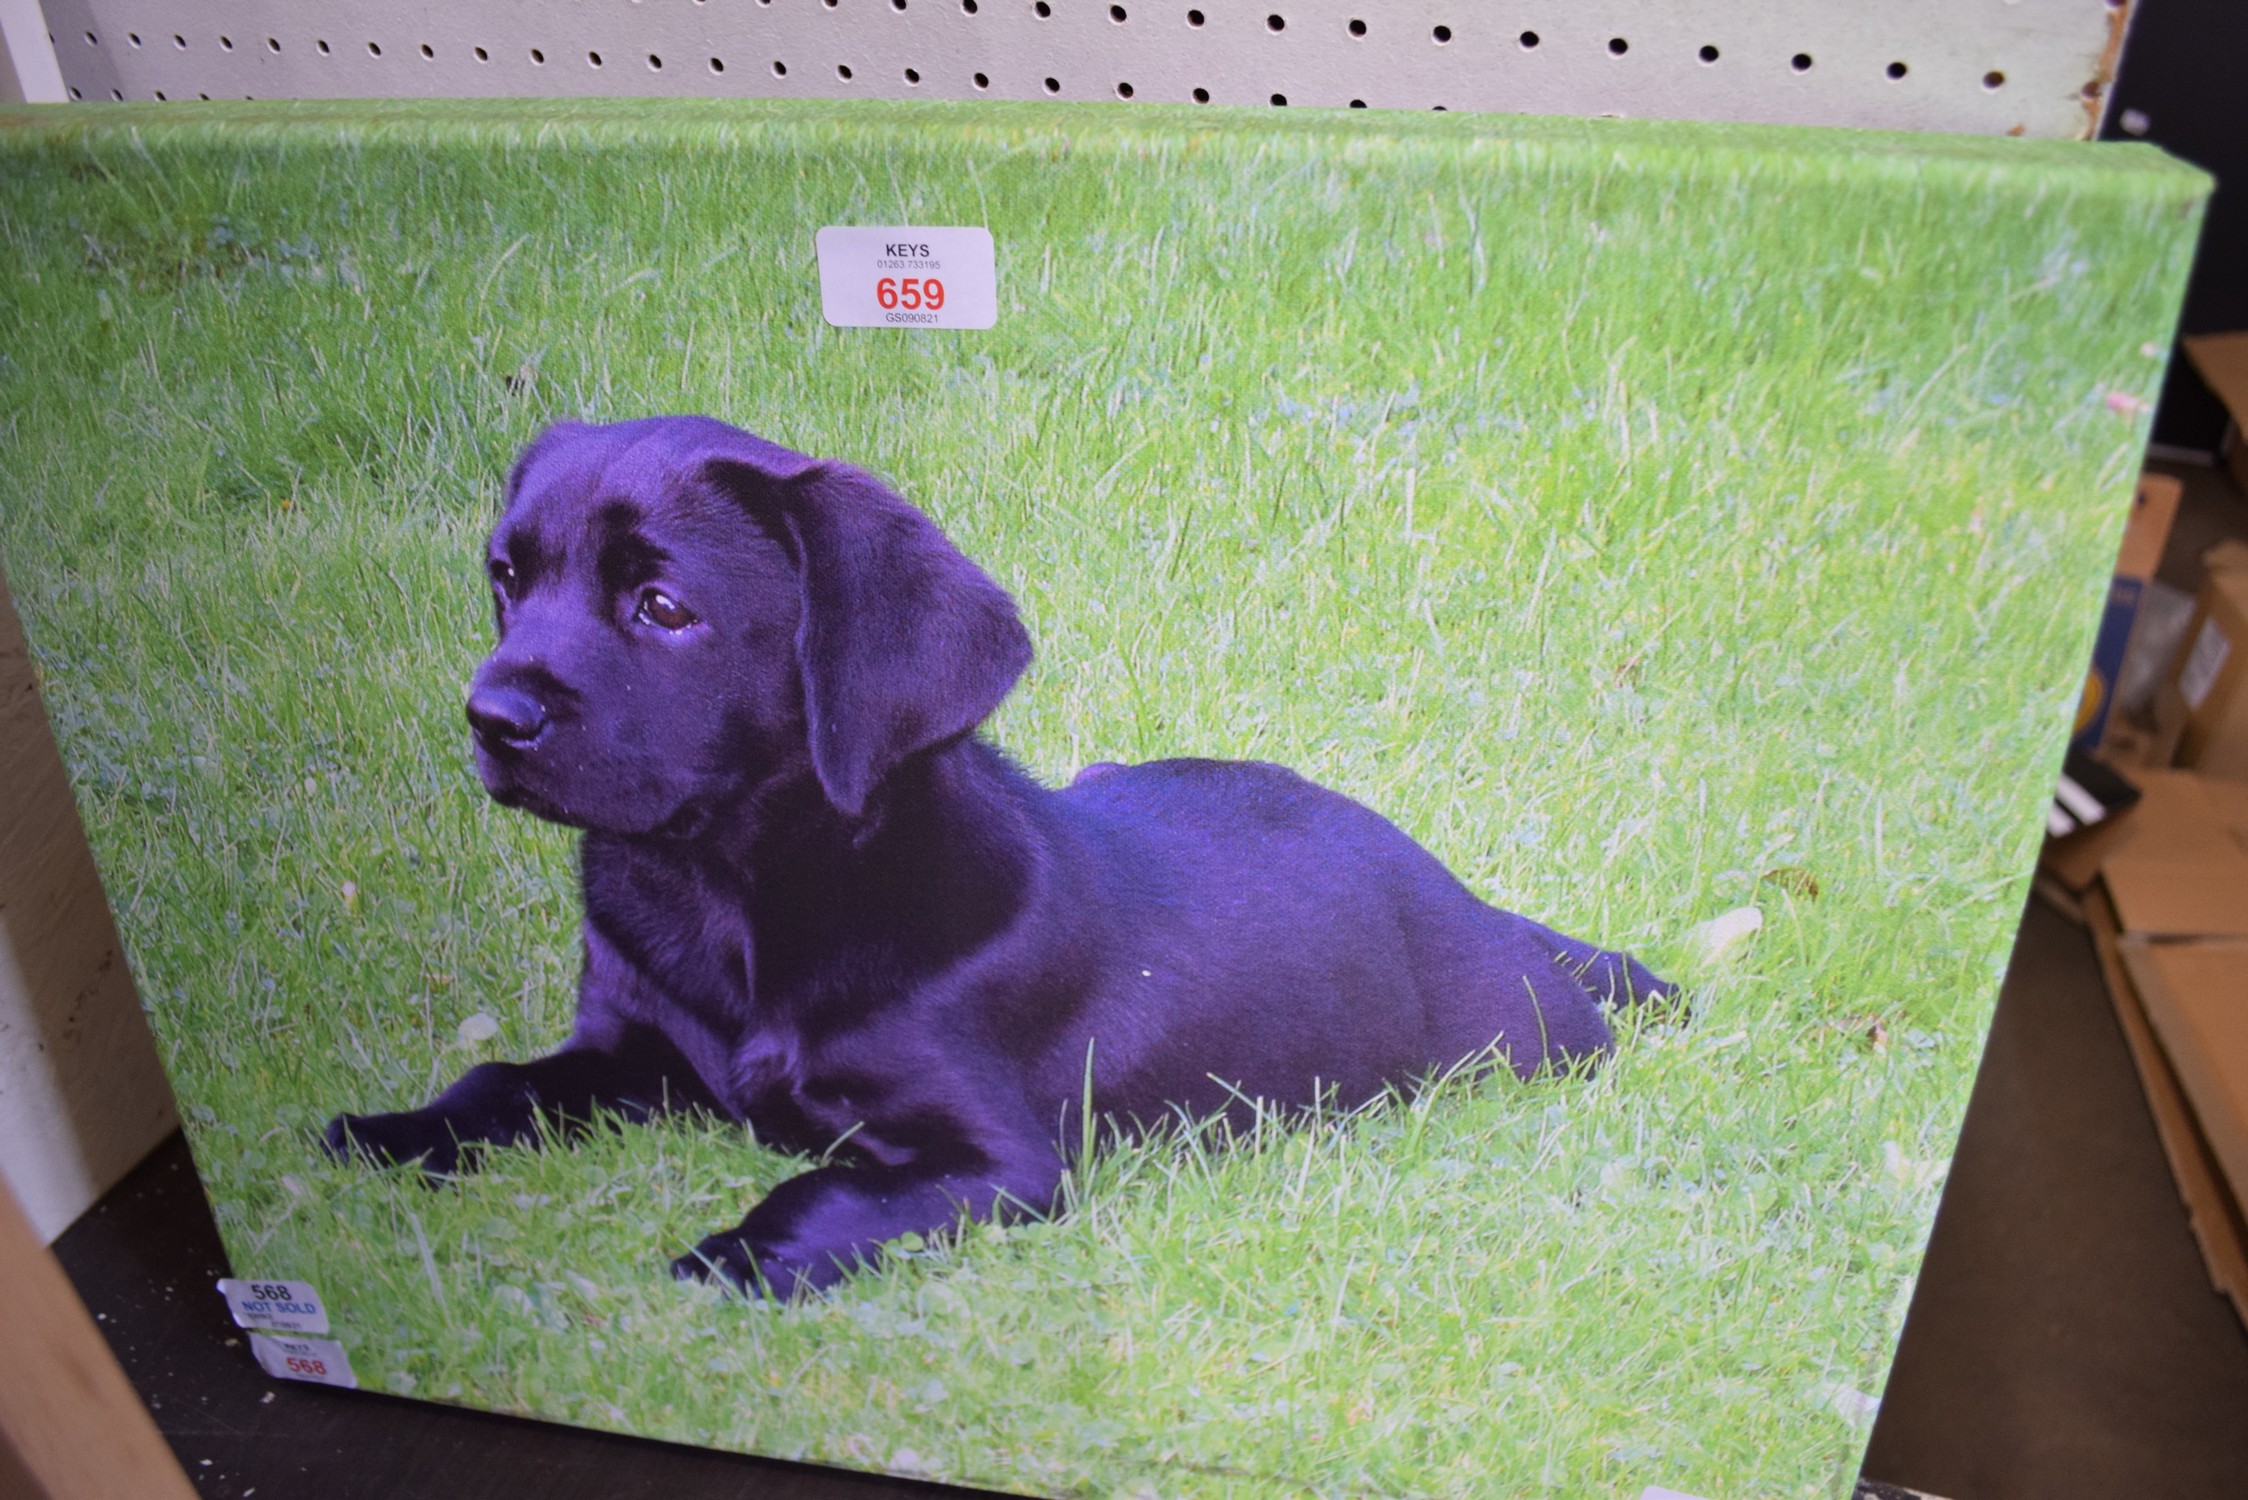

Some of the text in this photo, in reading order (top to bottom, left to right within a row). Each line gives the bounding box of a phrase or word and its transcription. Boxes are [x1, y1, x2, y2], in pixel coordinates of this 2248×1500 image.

[886, 244, 930, 257] KEYS
[877, 260, 941, 269] 01263 733195
[877, 277, 945, 310] 659
[885, 313, 938, 323] GS090821
[251, 1284, 292, 1301] 568
[241, 1301, 316, 1314] NOT SOLD
[286, 1357, 327, 1376] 568
